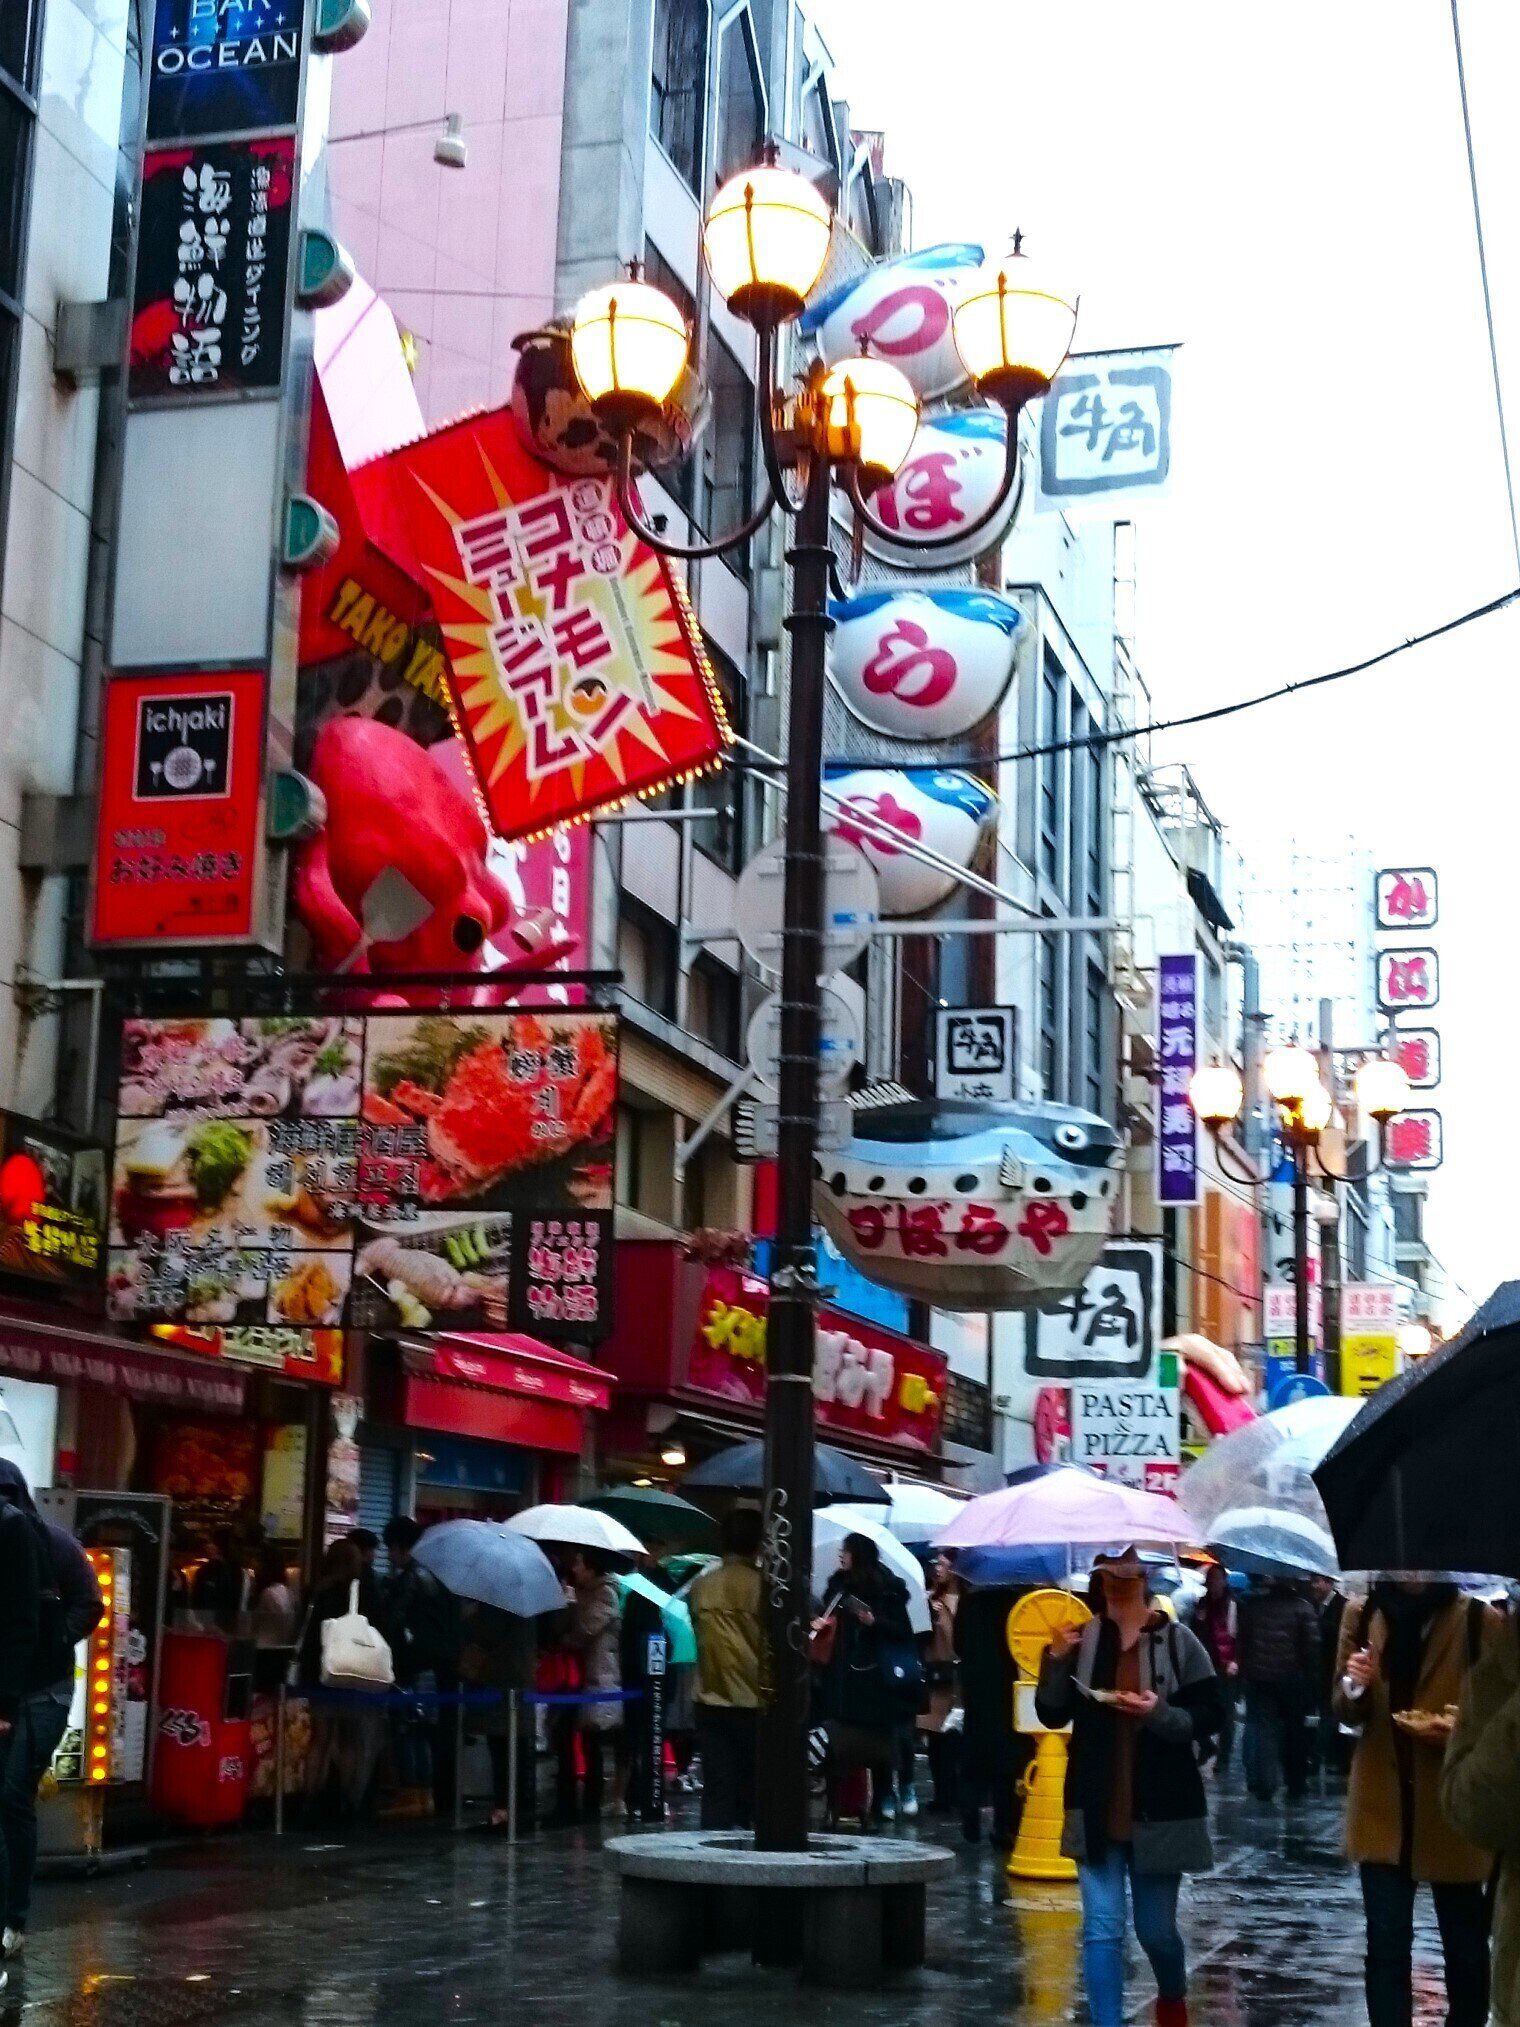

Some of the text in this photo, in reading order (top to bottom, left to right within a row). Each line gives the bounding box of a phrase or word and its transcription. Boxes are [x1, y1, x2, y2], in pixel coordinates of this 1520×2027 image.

[157, 33, 298, 74] OCEAN
[1060, 394, 1156, 462] 牛角
[330, 579, 446, 703] TAKO YA
[461, 516, 583, 768] ミュージアム
[953, 1027, 1003, 1060] 牛角
[848, 1201, 1068, 1256] づぼらや
[1082, 1394, 1174, 1418] PASTA
[1084, 1433, 1174, 1456] PIZZA
